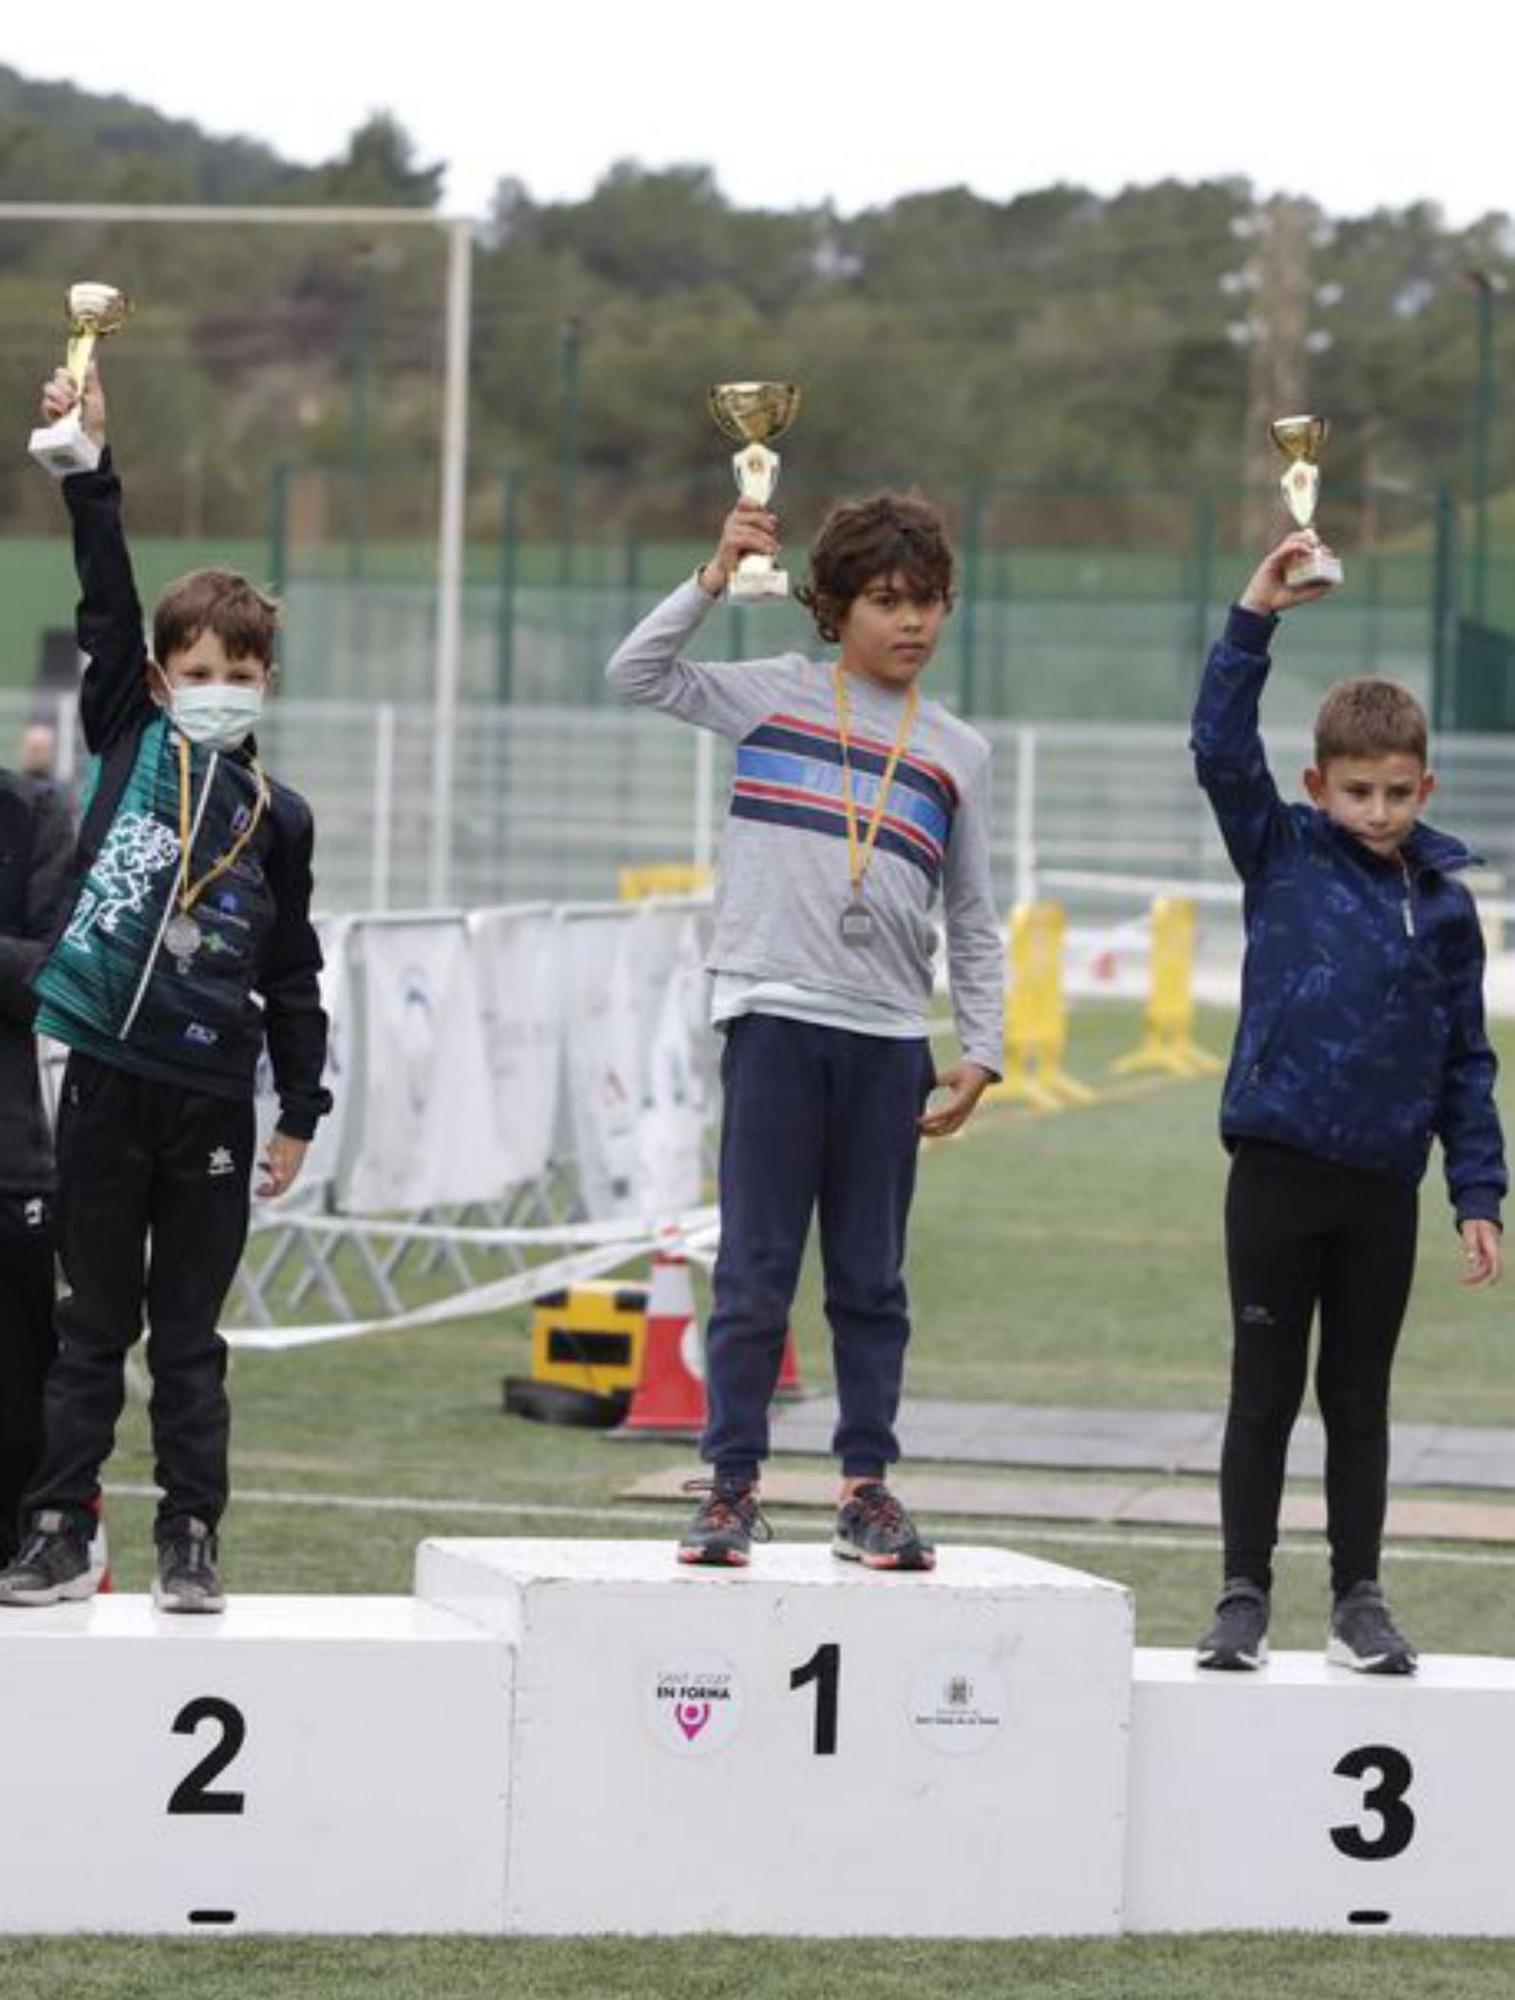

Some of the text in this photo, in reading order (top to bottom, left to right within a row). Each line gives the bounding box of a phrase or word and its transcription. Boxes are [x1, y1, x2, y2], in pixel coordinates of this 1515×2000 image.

[657, 1686, 731, 1700] EN FORMA
[790, 1644, 840, 1755] 1
[167, 1696, 245, 1815] 2
[1329, 1745, 1415, 1861] 3
